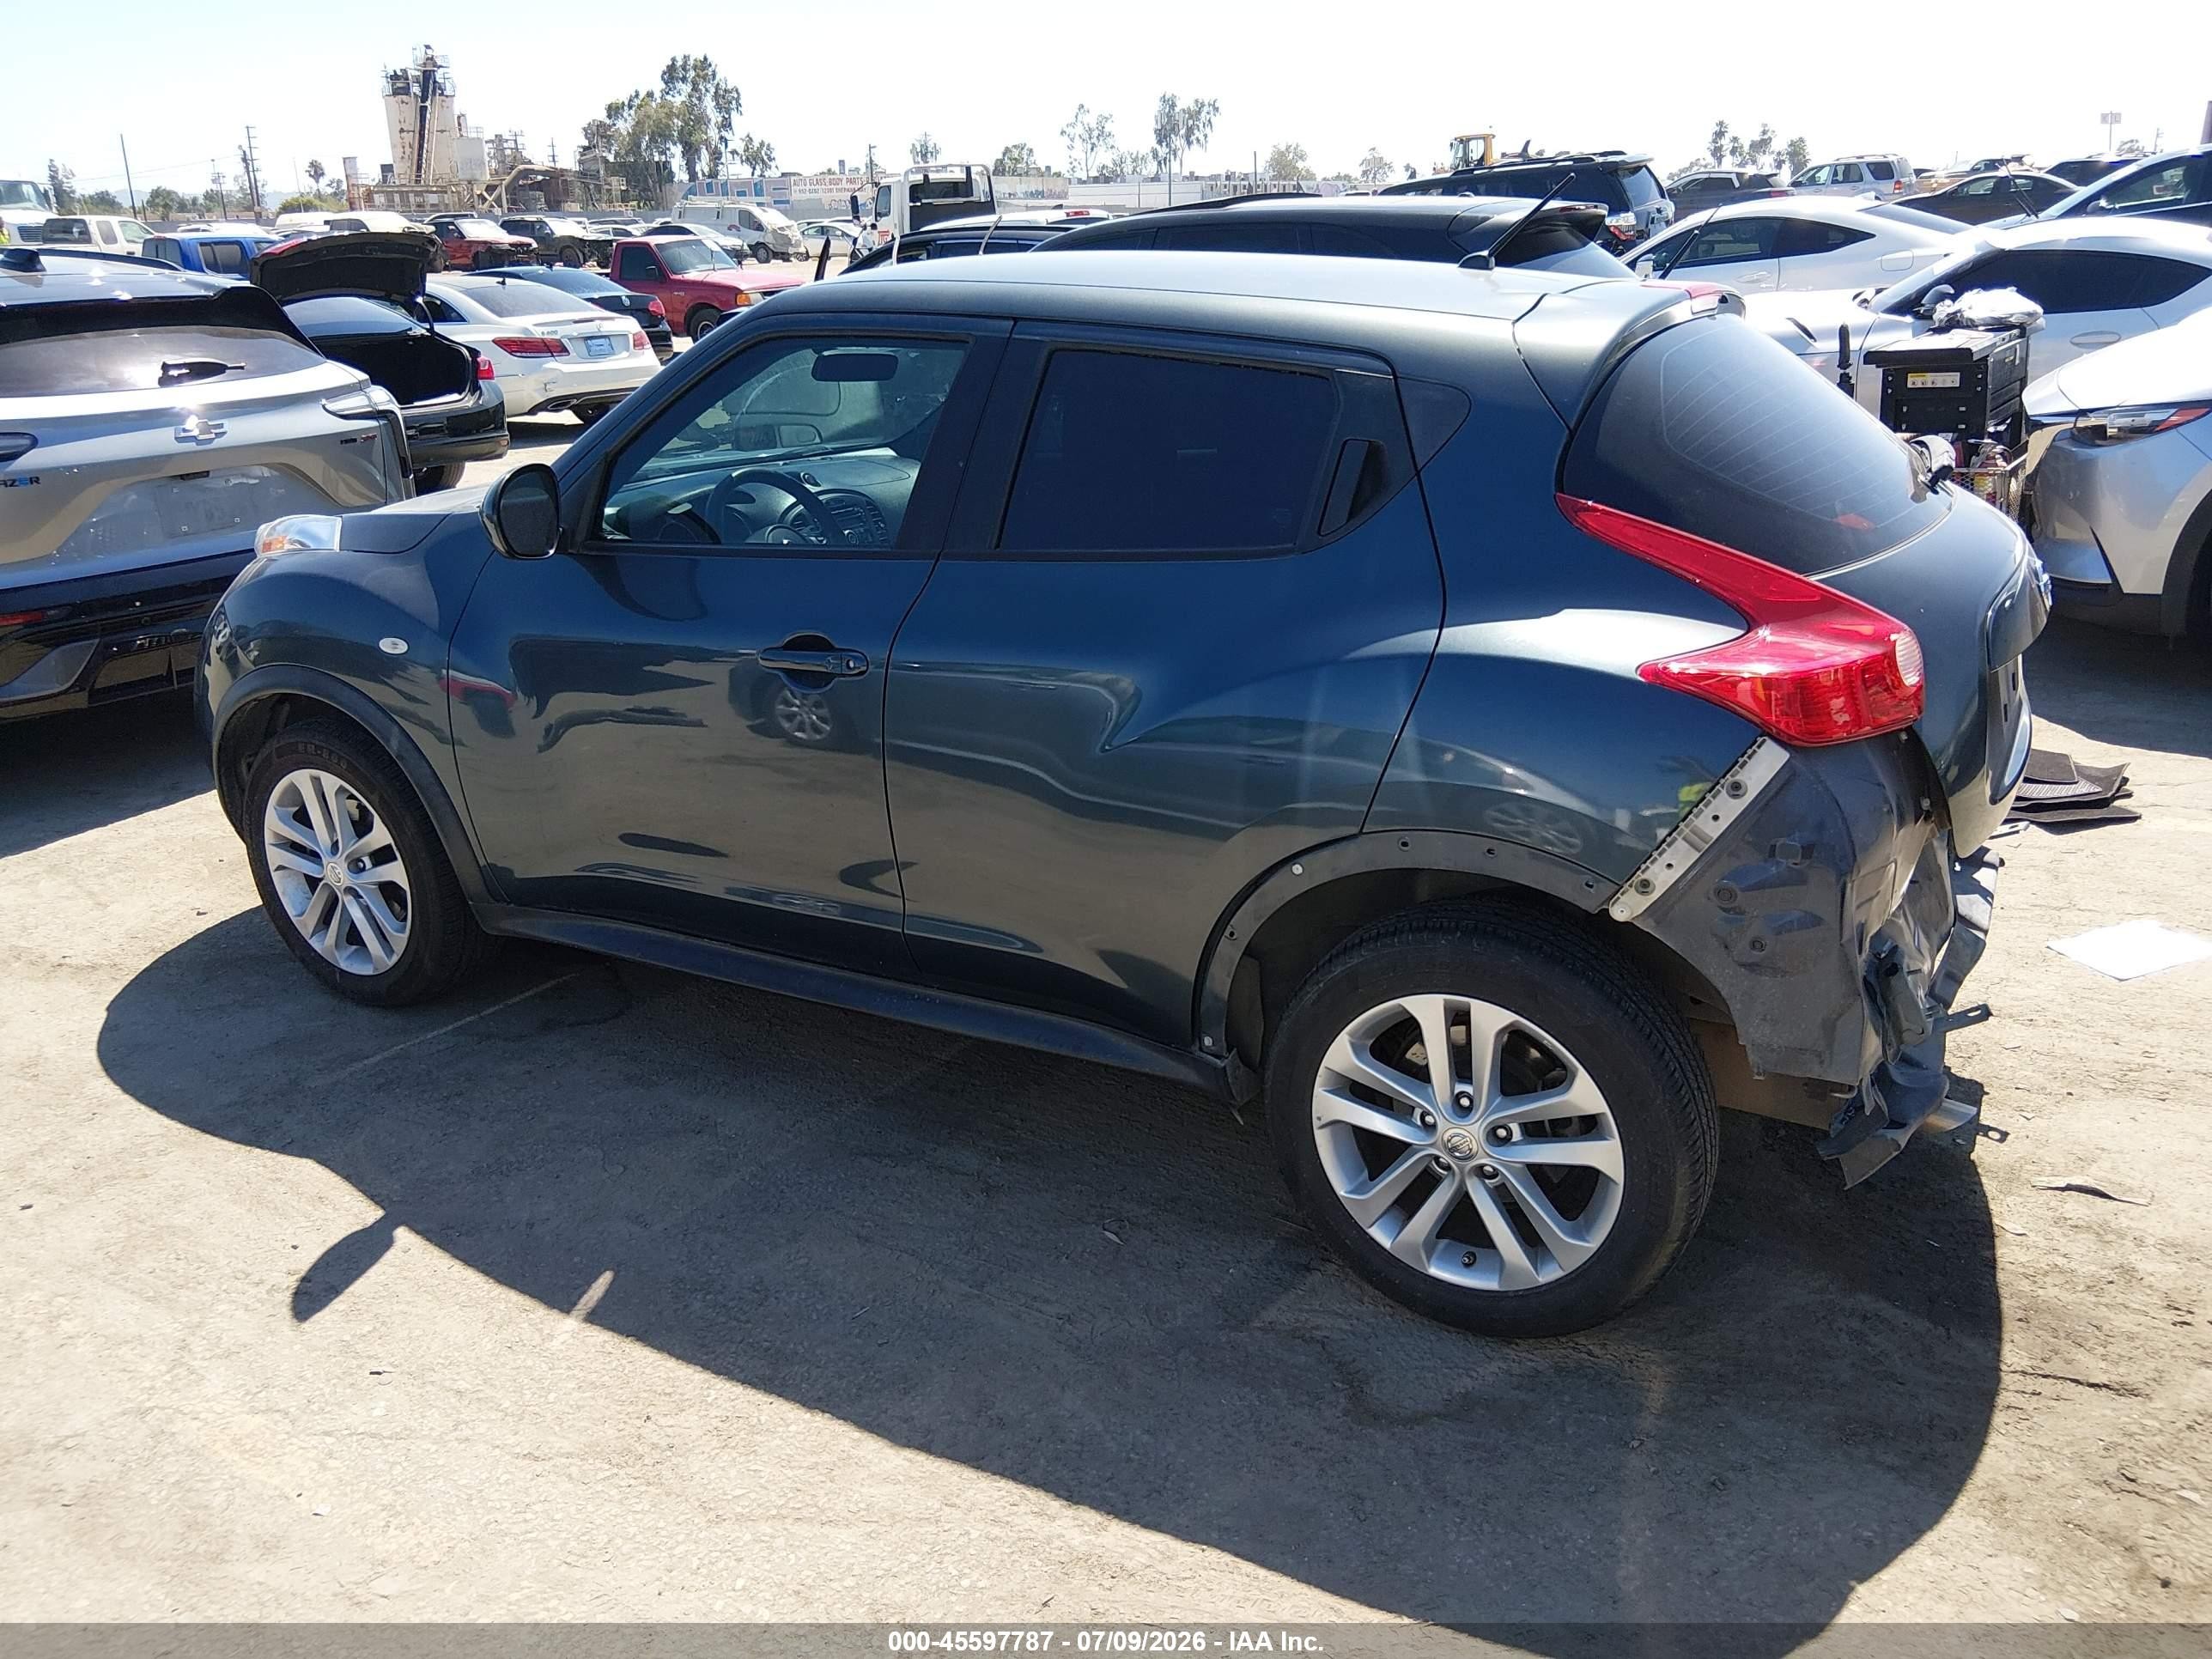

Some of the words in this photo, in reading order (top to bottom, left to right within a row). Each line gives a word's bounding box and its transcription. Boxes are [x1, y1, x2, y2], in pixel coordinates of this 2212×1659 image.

[793, 179, 807, 187] AUTO
[809, 178, 827, 186] GLASS
[829, 177, 843, 186] BODY
[846, 177, 864, 185] PARTS
